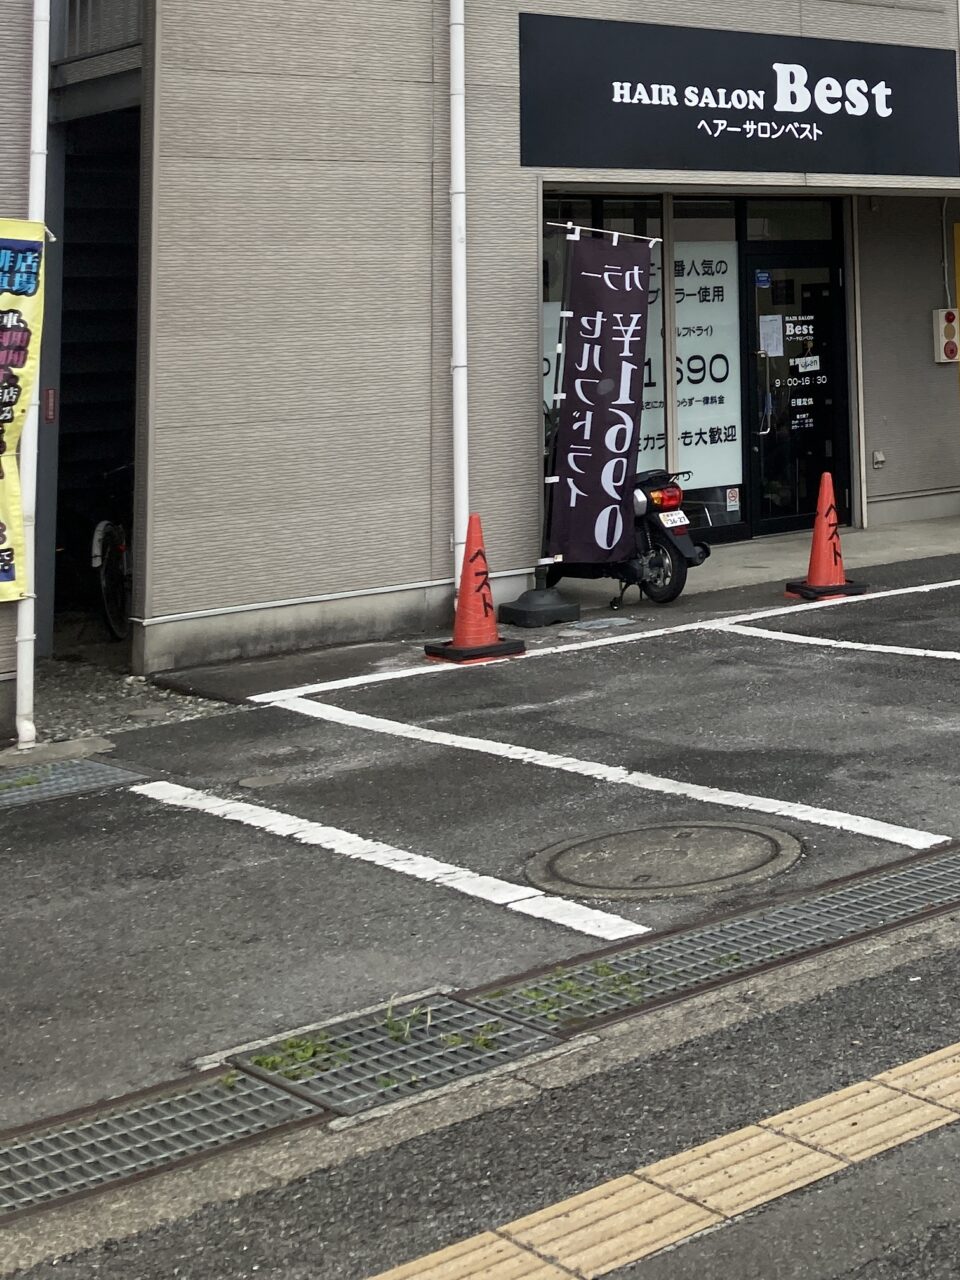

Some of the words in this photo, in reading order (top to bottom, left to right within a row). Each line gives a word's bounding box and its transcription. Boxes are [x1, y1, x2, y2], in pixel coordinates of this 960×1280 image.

[612, 81, 678, 106] HAIR
[684, 85, 765, 111] SALON
[773, 62, 893, 118] Best
[697, 118, 823, 141] ヘアーサロンベスト
[785, 322, 814, 335] Best
